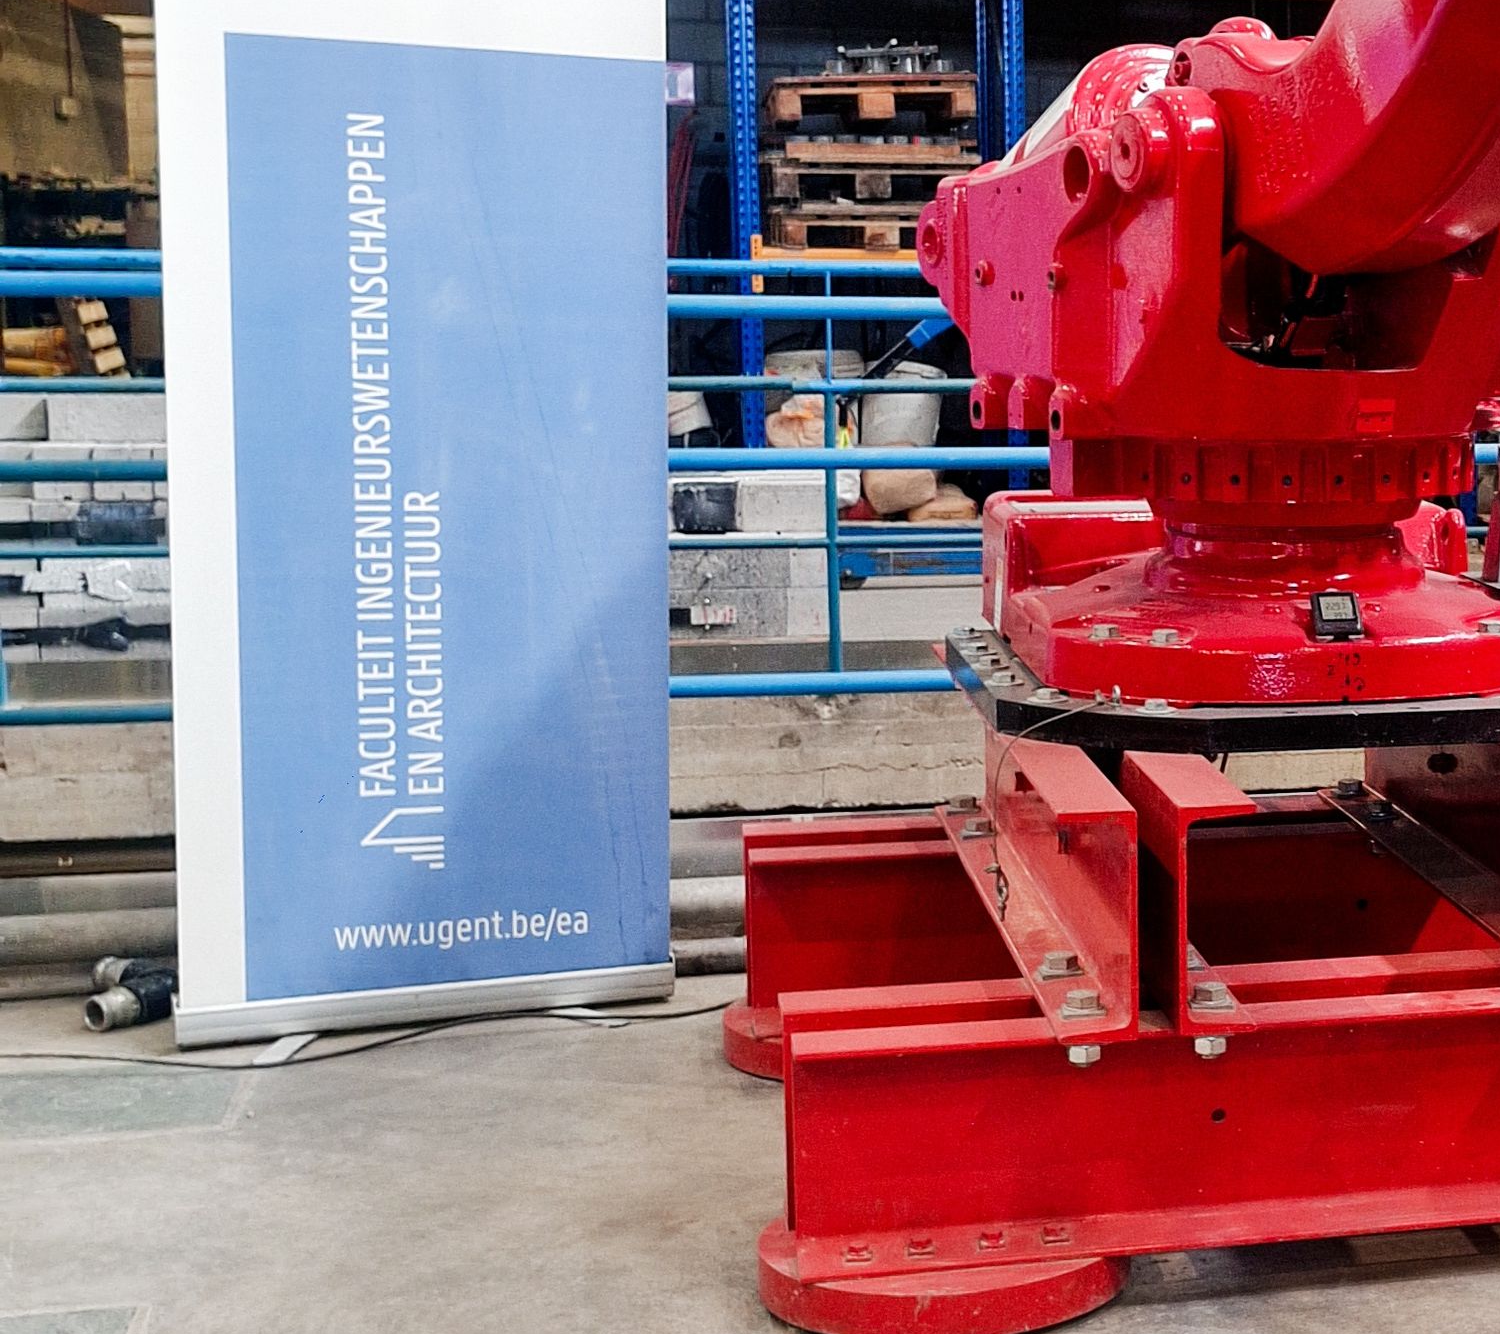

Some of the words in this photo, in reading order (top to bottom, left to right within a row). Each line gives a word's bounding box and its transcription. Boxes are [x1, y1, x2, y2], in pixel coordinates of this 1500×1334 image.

[346, 113, 394, 621] INGENIEURSWETENSCHAPPEN
[403, 490, 445, 742] ARCHITECTUUR
[356, 629, 397, 798] FACULTEIT
[408, 752, 445, 796] EN
[334, 907, 590, 951] www.ugent.be/ea
